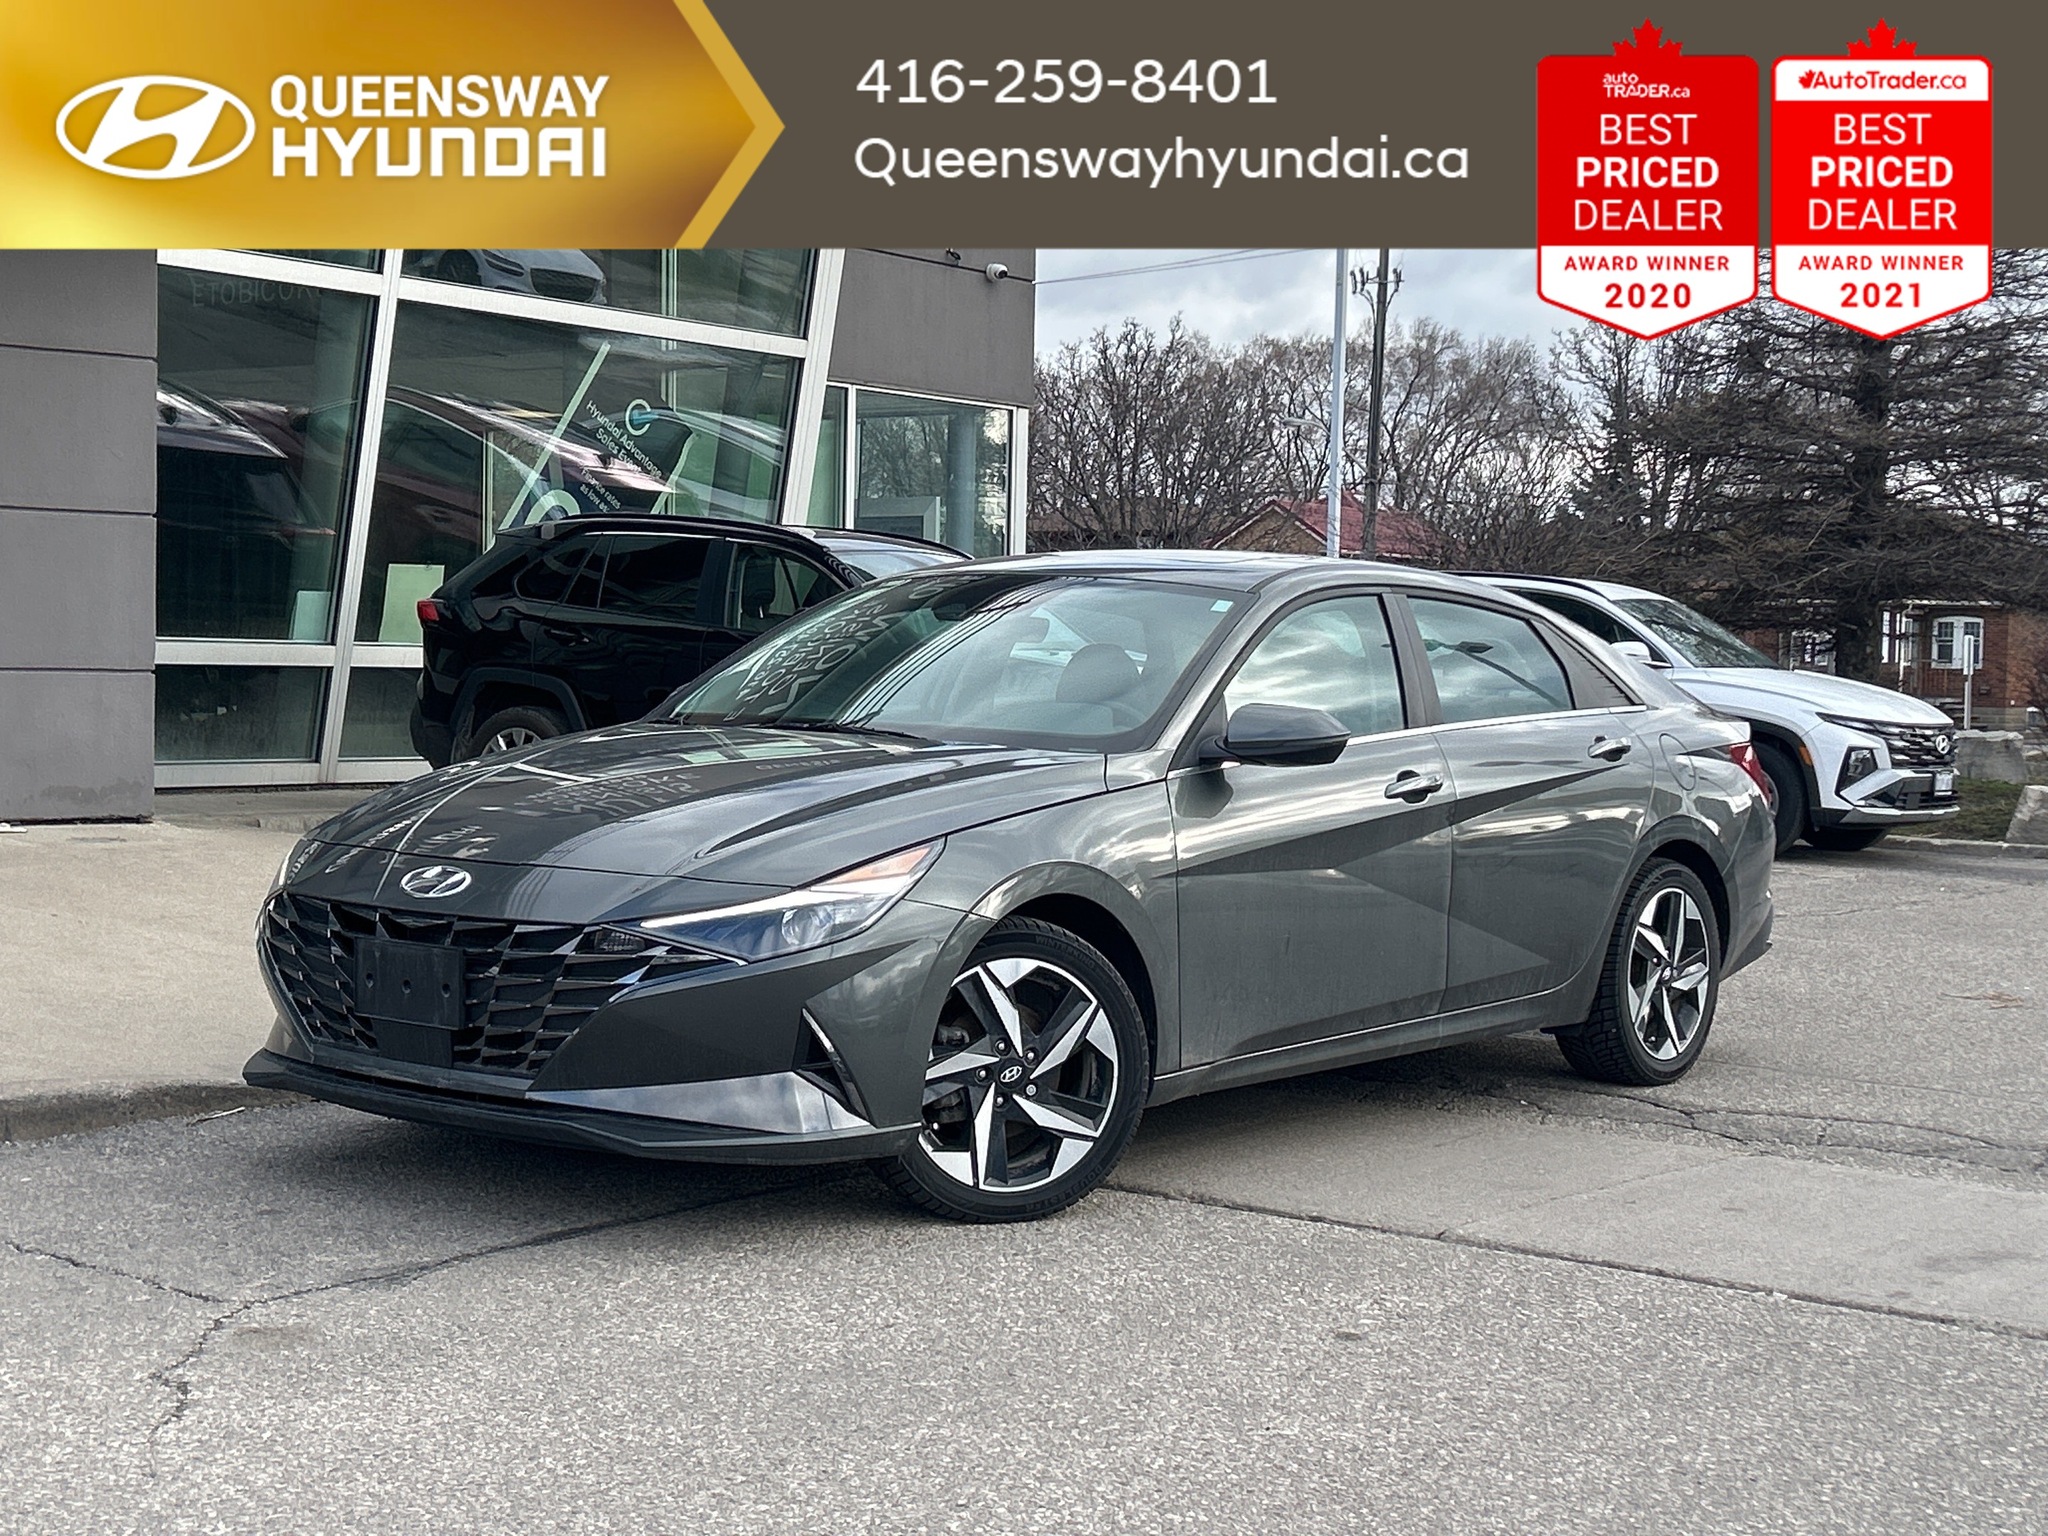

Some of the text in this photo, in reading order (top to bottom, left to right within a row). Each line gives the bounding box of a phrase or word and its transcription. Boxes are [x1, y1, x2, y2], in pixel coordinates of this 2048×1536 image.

[586, 400, 662, 479] Hyundai Advantage
[595, 428, 620, 455] Sales
